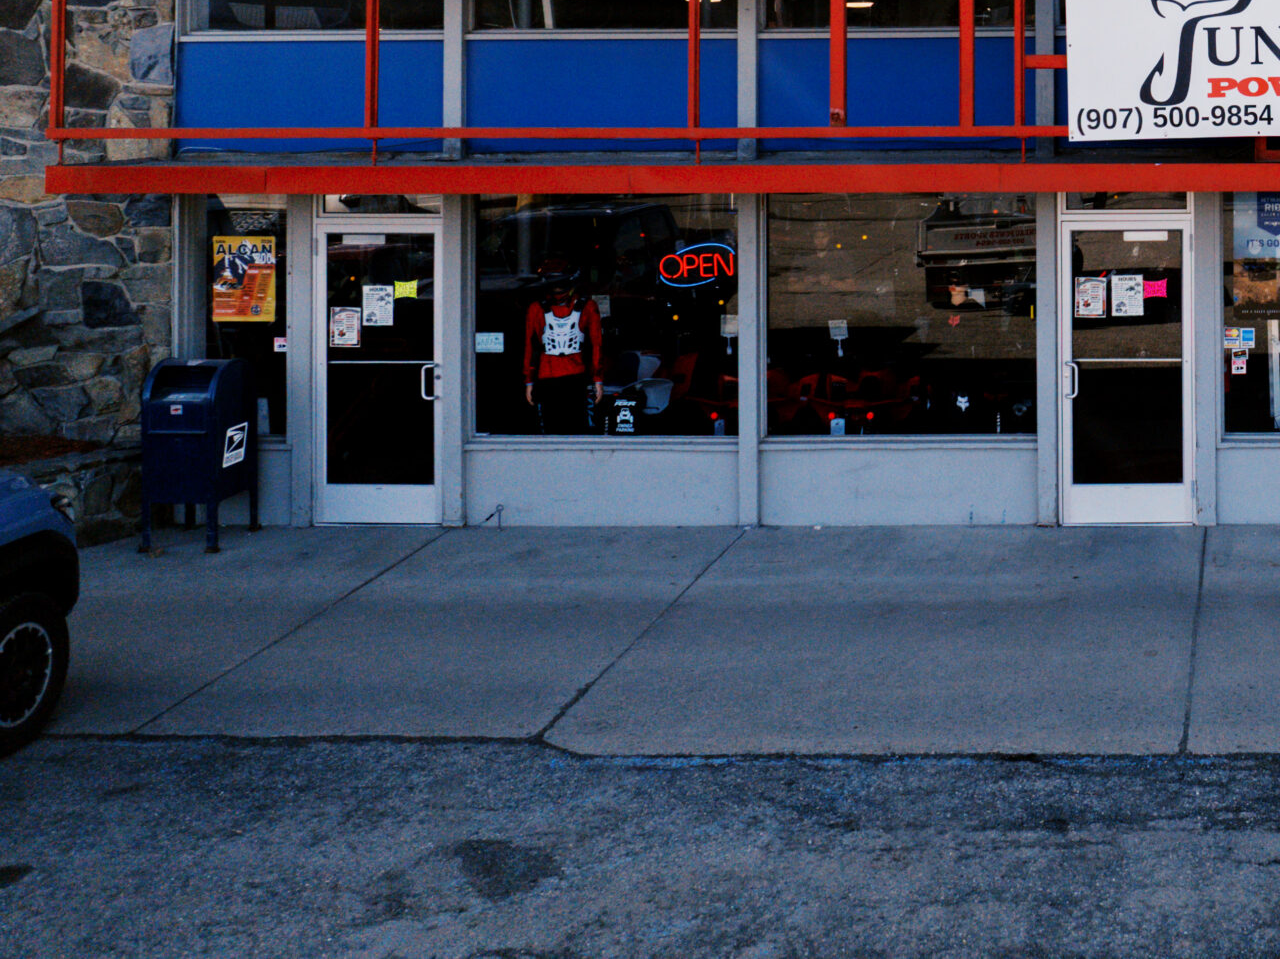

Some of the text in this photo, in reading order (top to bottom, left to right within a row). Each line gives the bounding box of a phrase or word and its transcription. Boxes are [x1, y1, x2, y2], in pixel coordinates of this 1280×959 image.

[1076, 104, 1274, 134] (907) 500-9854
[216, 244, 273, 255] ALCAN
[1266, 239, 1280, 248] GO
[659, 253, 734, 278] OPEN
